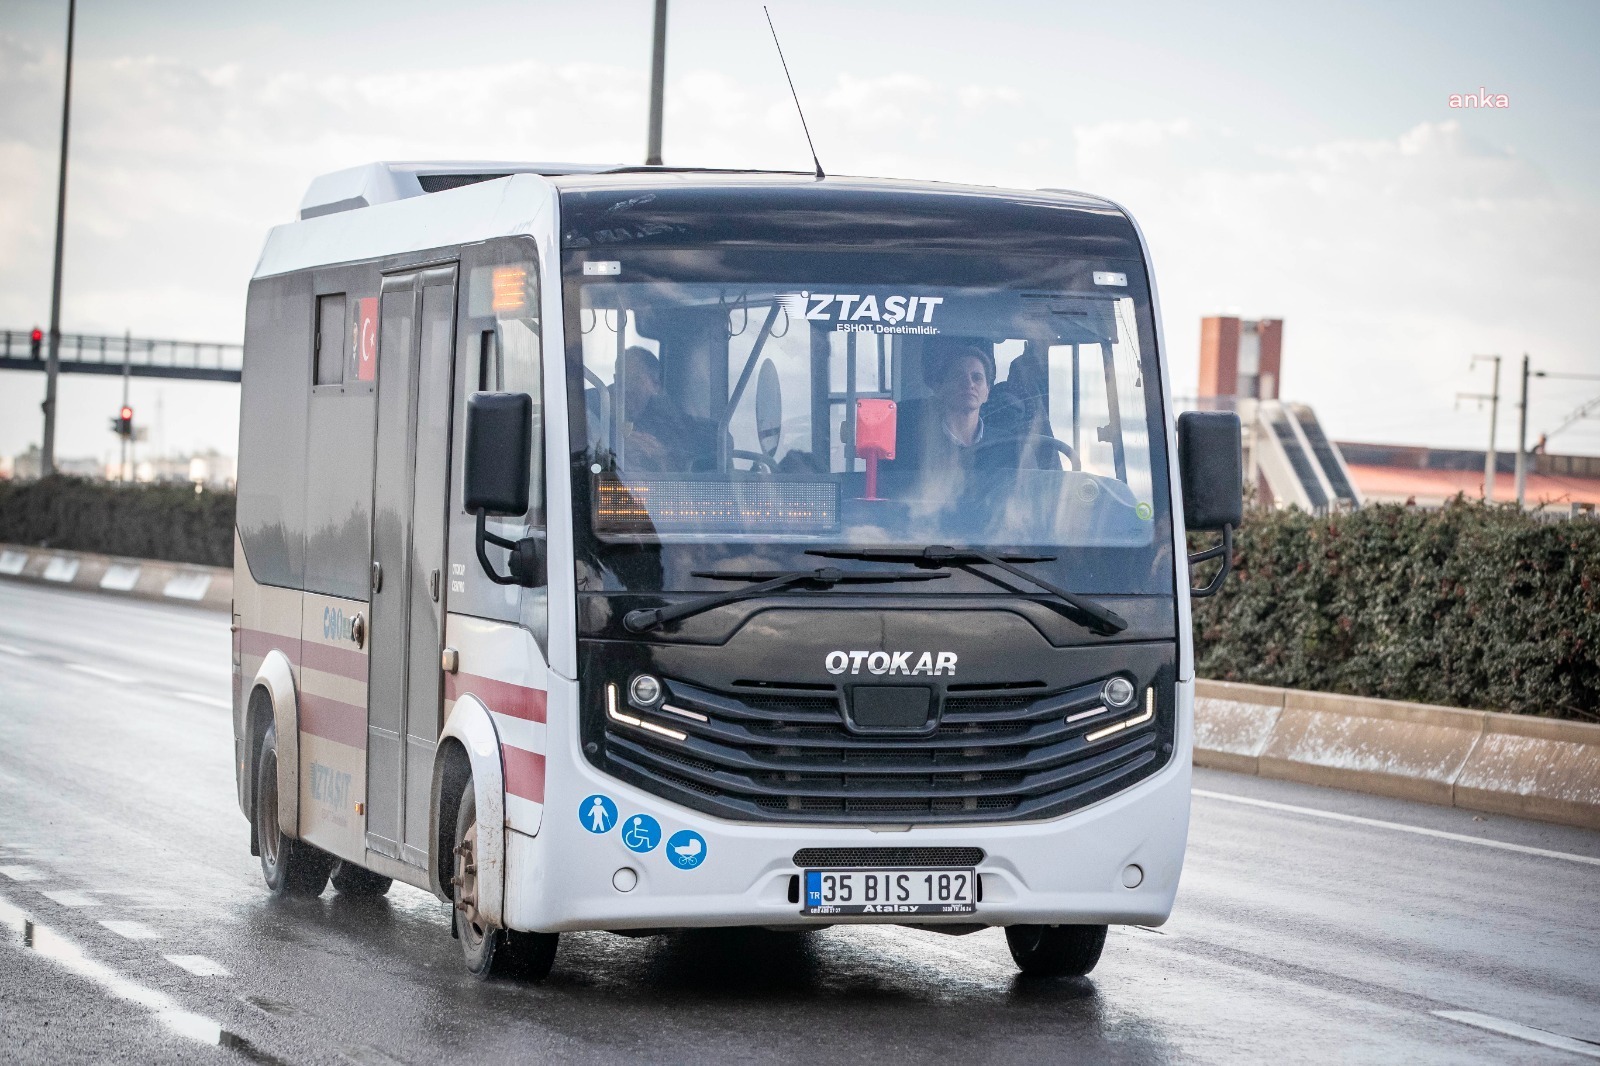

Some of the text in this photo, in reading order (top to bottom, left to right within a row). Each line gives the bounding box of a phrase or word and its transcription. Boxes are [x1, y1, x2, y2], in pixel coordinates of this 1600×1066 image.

[836, 323, 873, 333] ESHOT
[825, 650, 958, 675] OTOKAR
[810, 874, 967, 901] TR 35 BIS 182
[862, 904, 919, 913] Atalay
